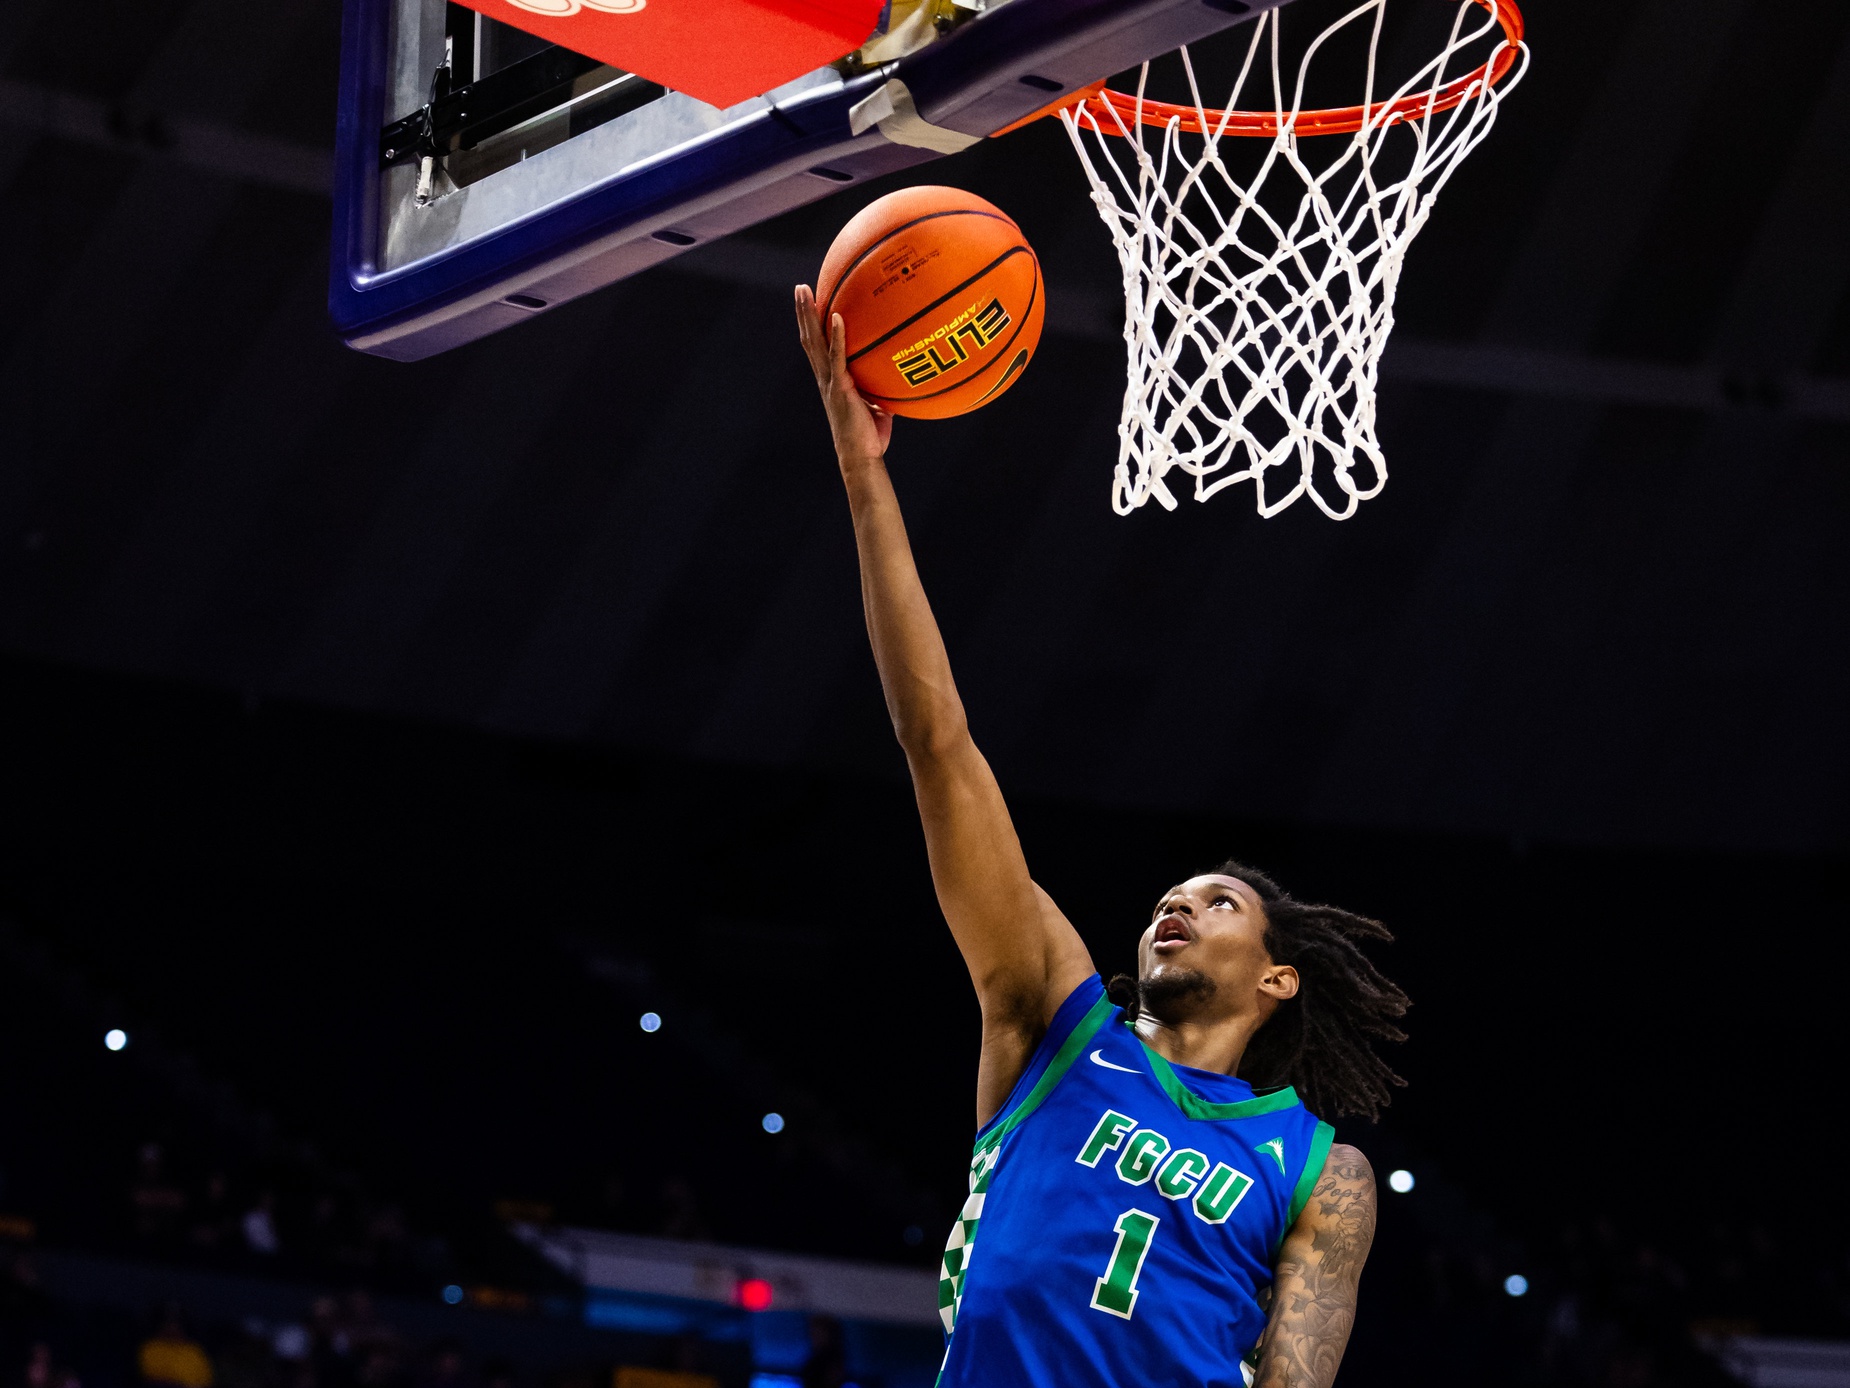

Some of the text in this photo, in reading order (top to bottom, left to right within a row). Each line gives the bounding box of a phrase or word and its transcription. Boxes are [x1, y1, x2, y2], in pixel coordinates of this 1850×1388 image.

[892, 291, 991, 362] HAMPIONSHIP
[896, 297, 1011, 388] ELITE
[1075, 1109, 1255, 1225] FGCU
[1089, 1208, 1160, 1320] 1
